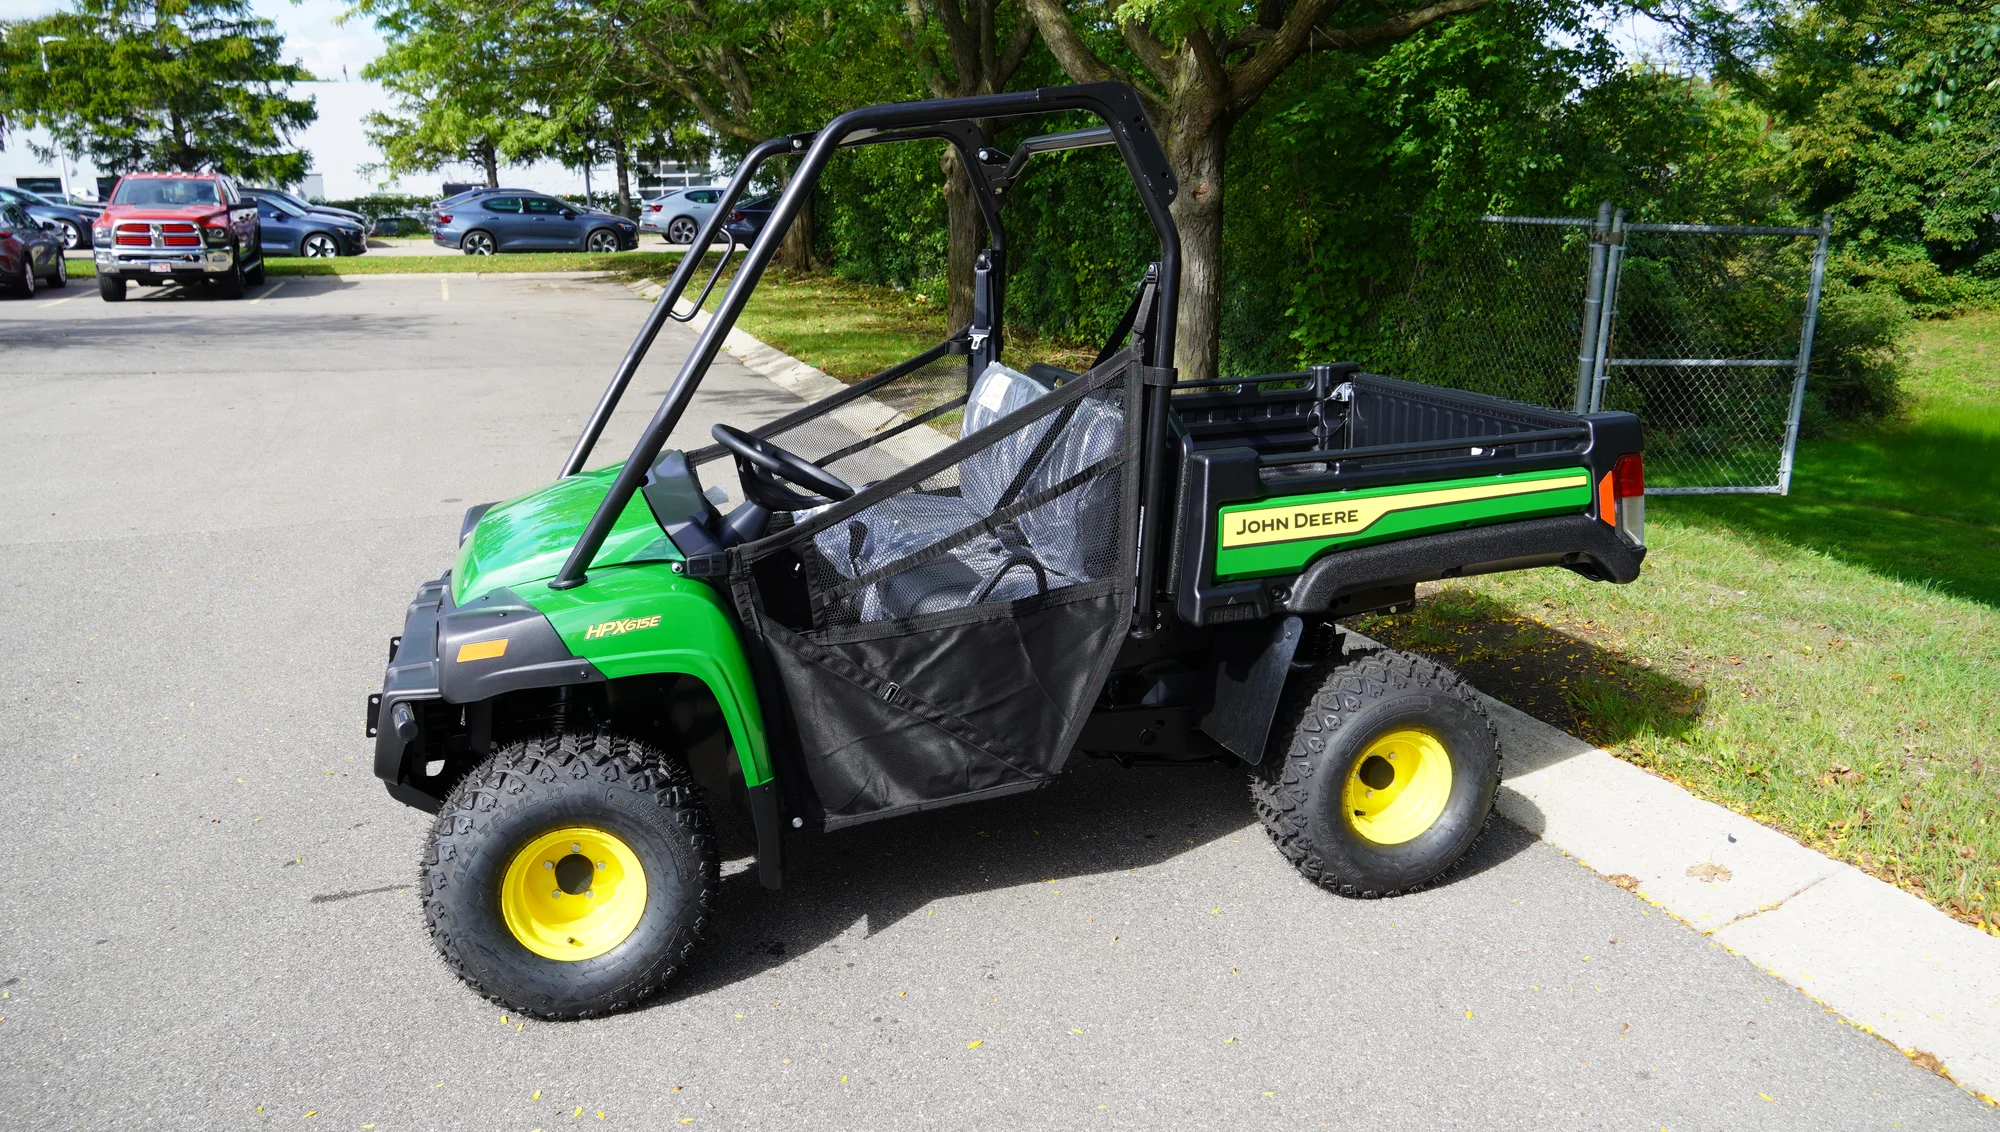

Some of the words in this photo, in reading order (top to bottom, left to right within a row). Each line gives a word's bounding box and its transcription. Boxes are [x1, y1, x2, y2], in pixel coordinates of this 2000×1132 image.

[1235, 517, 1289, 535] JOHN
[1294, 510, 1359, 529] DEERE
[585, 615, 662, 641] HPX615E
[478, 795, 540, 838] TRAIL
